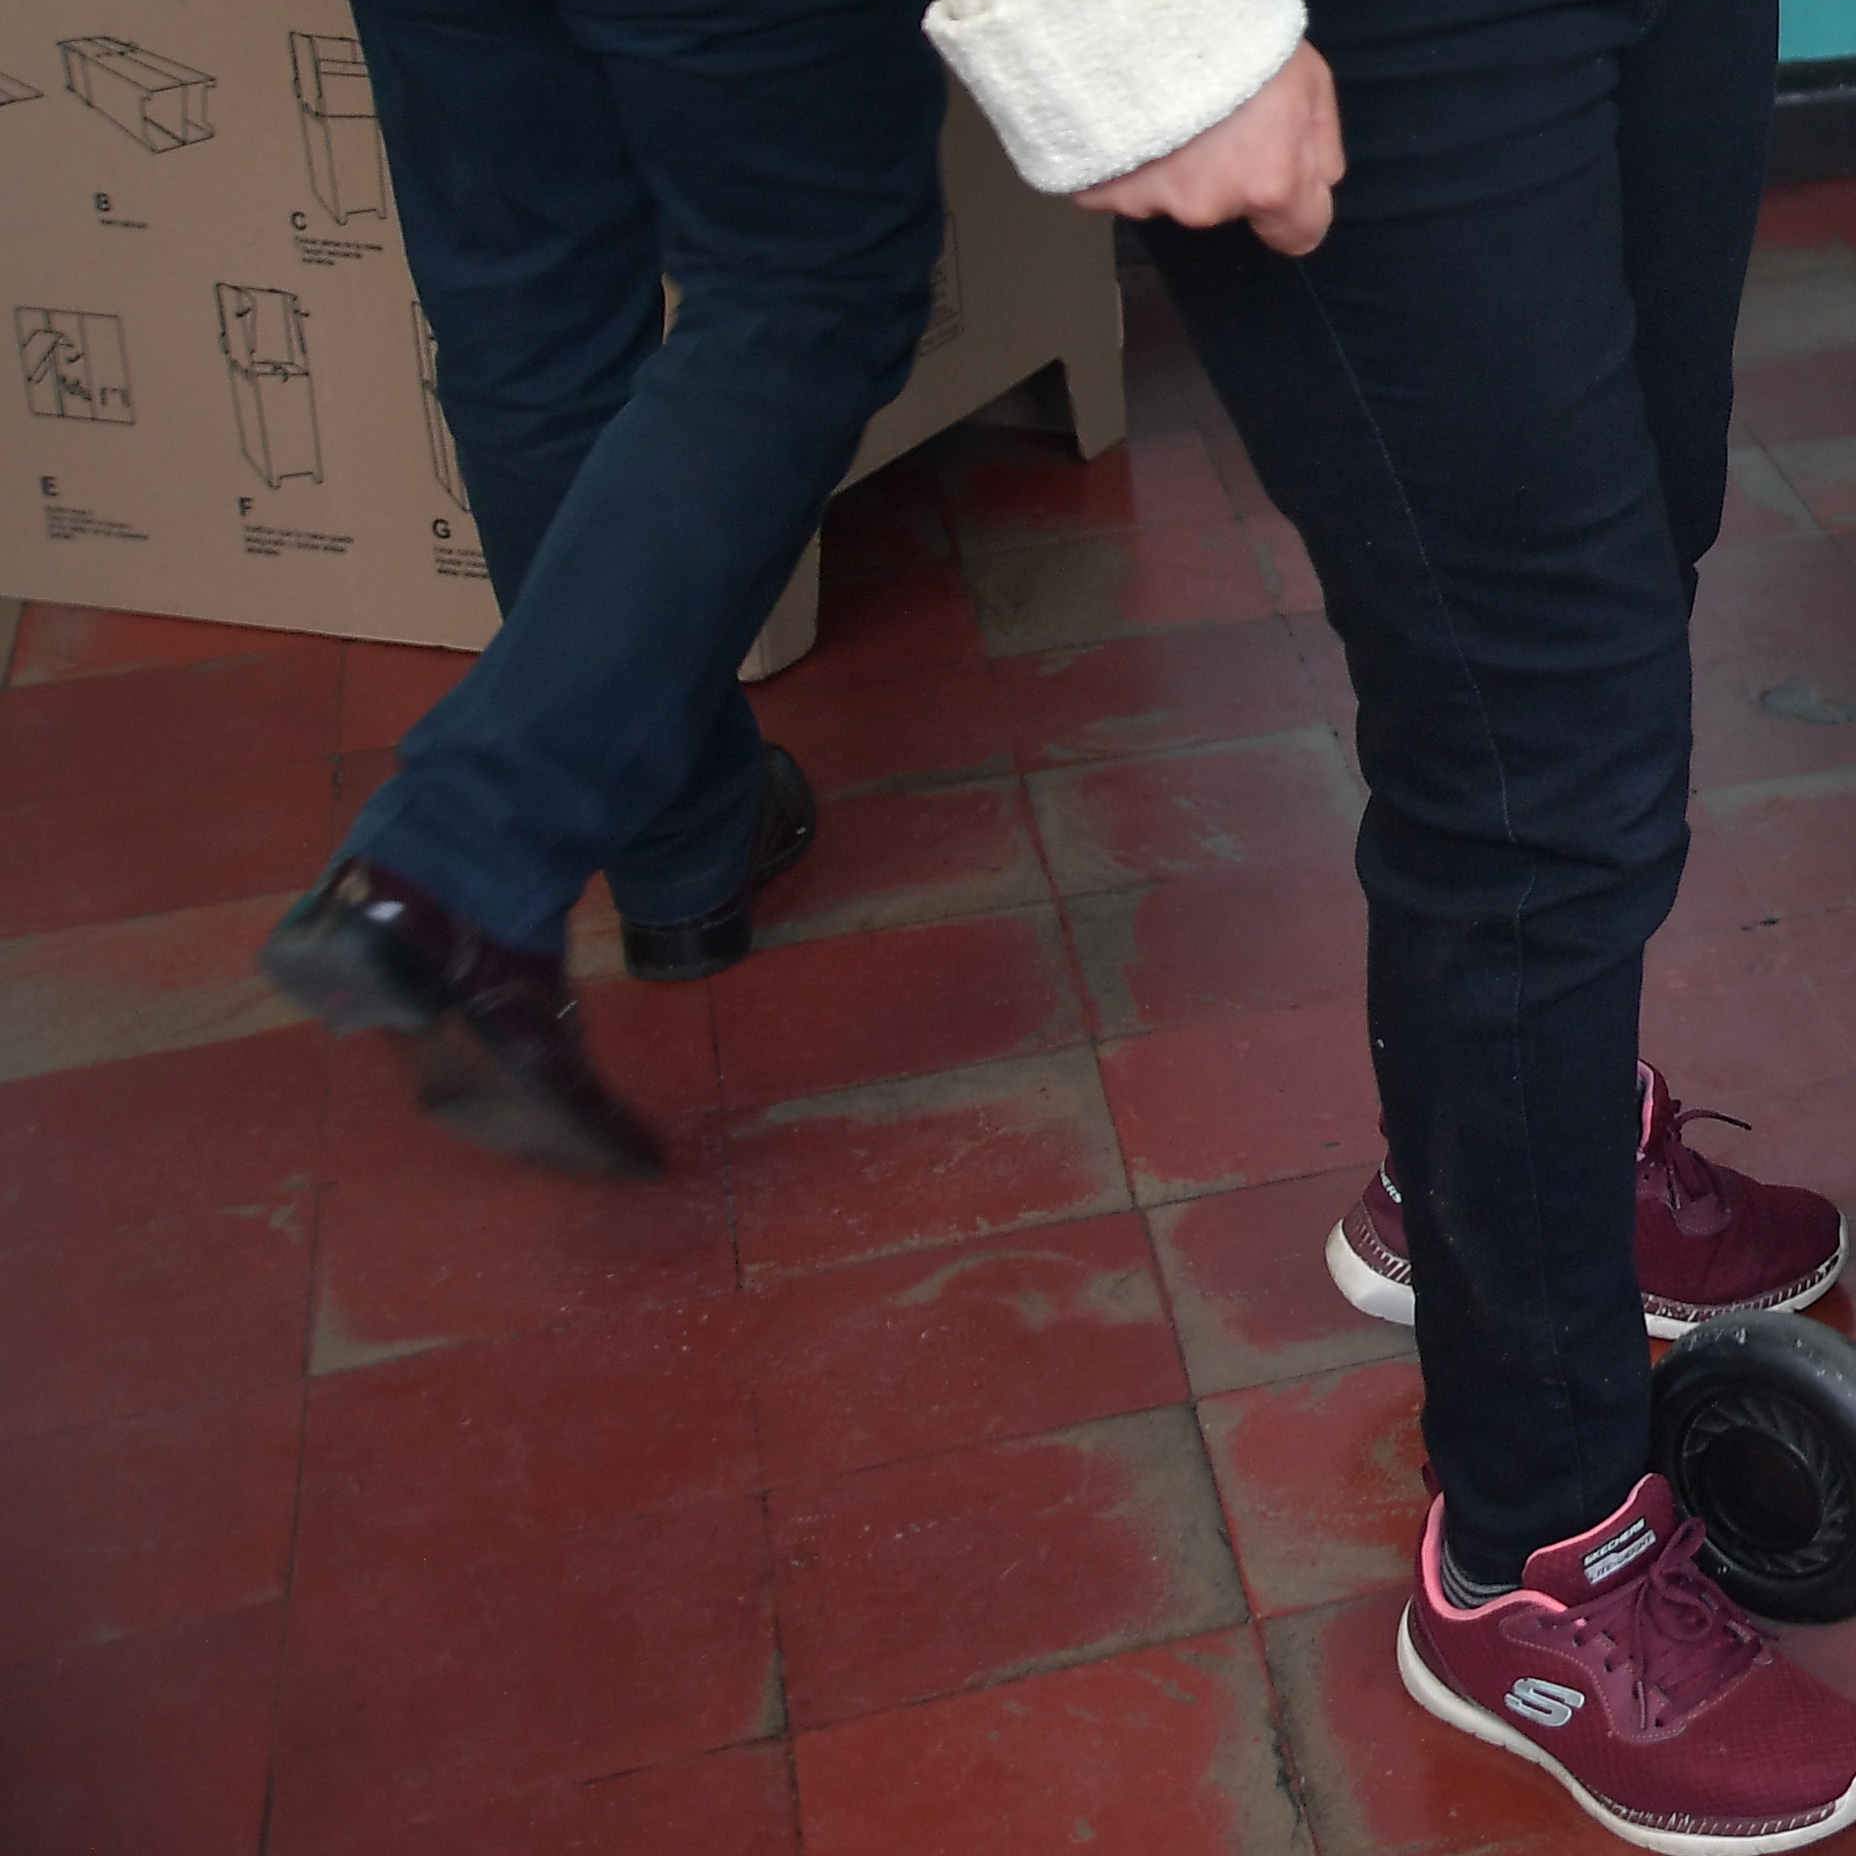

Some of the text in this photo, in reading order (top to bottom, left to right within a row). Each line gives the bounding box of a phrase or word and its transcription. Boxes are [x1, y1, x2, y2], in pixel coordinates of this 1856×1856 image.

[97, 193, 110, 212] B
[292, 211, 307, 231] C
[41, 476, 58, 497] E
[239, 497, 253, 517] F
[432, 518, 451, 539] G
